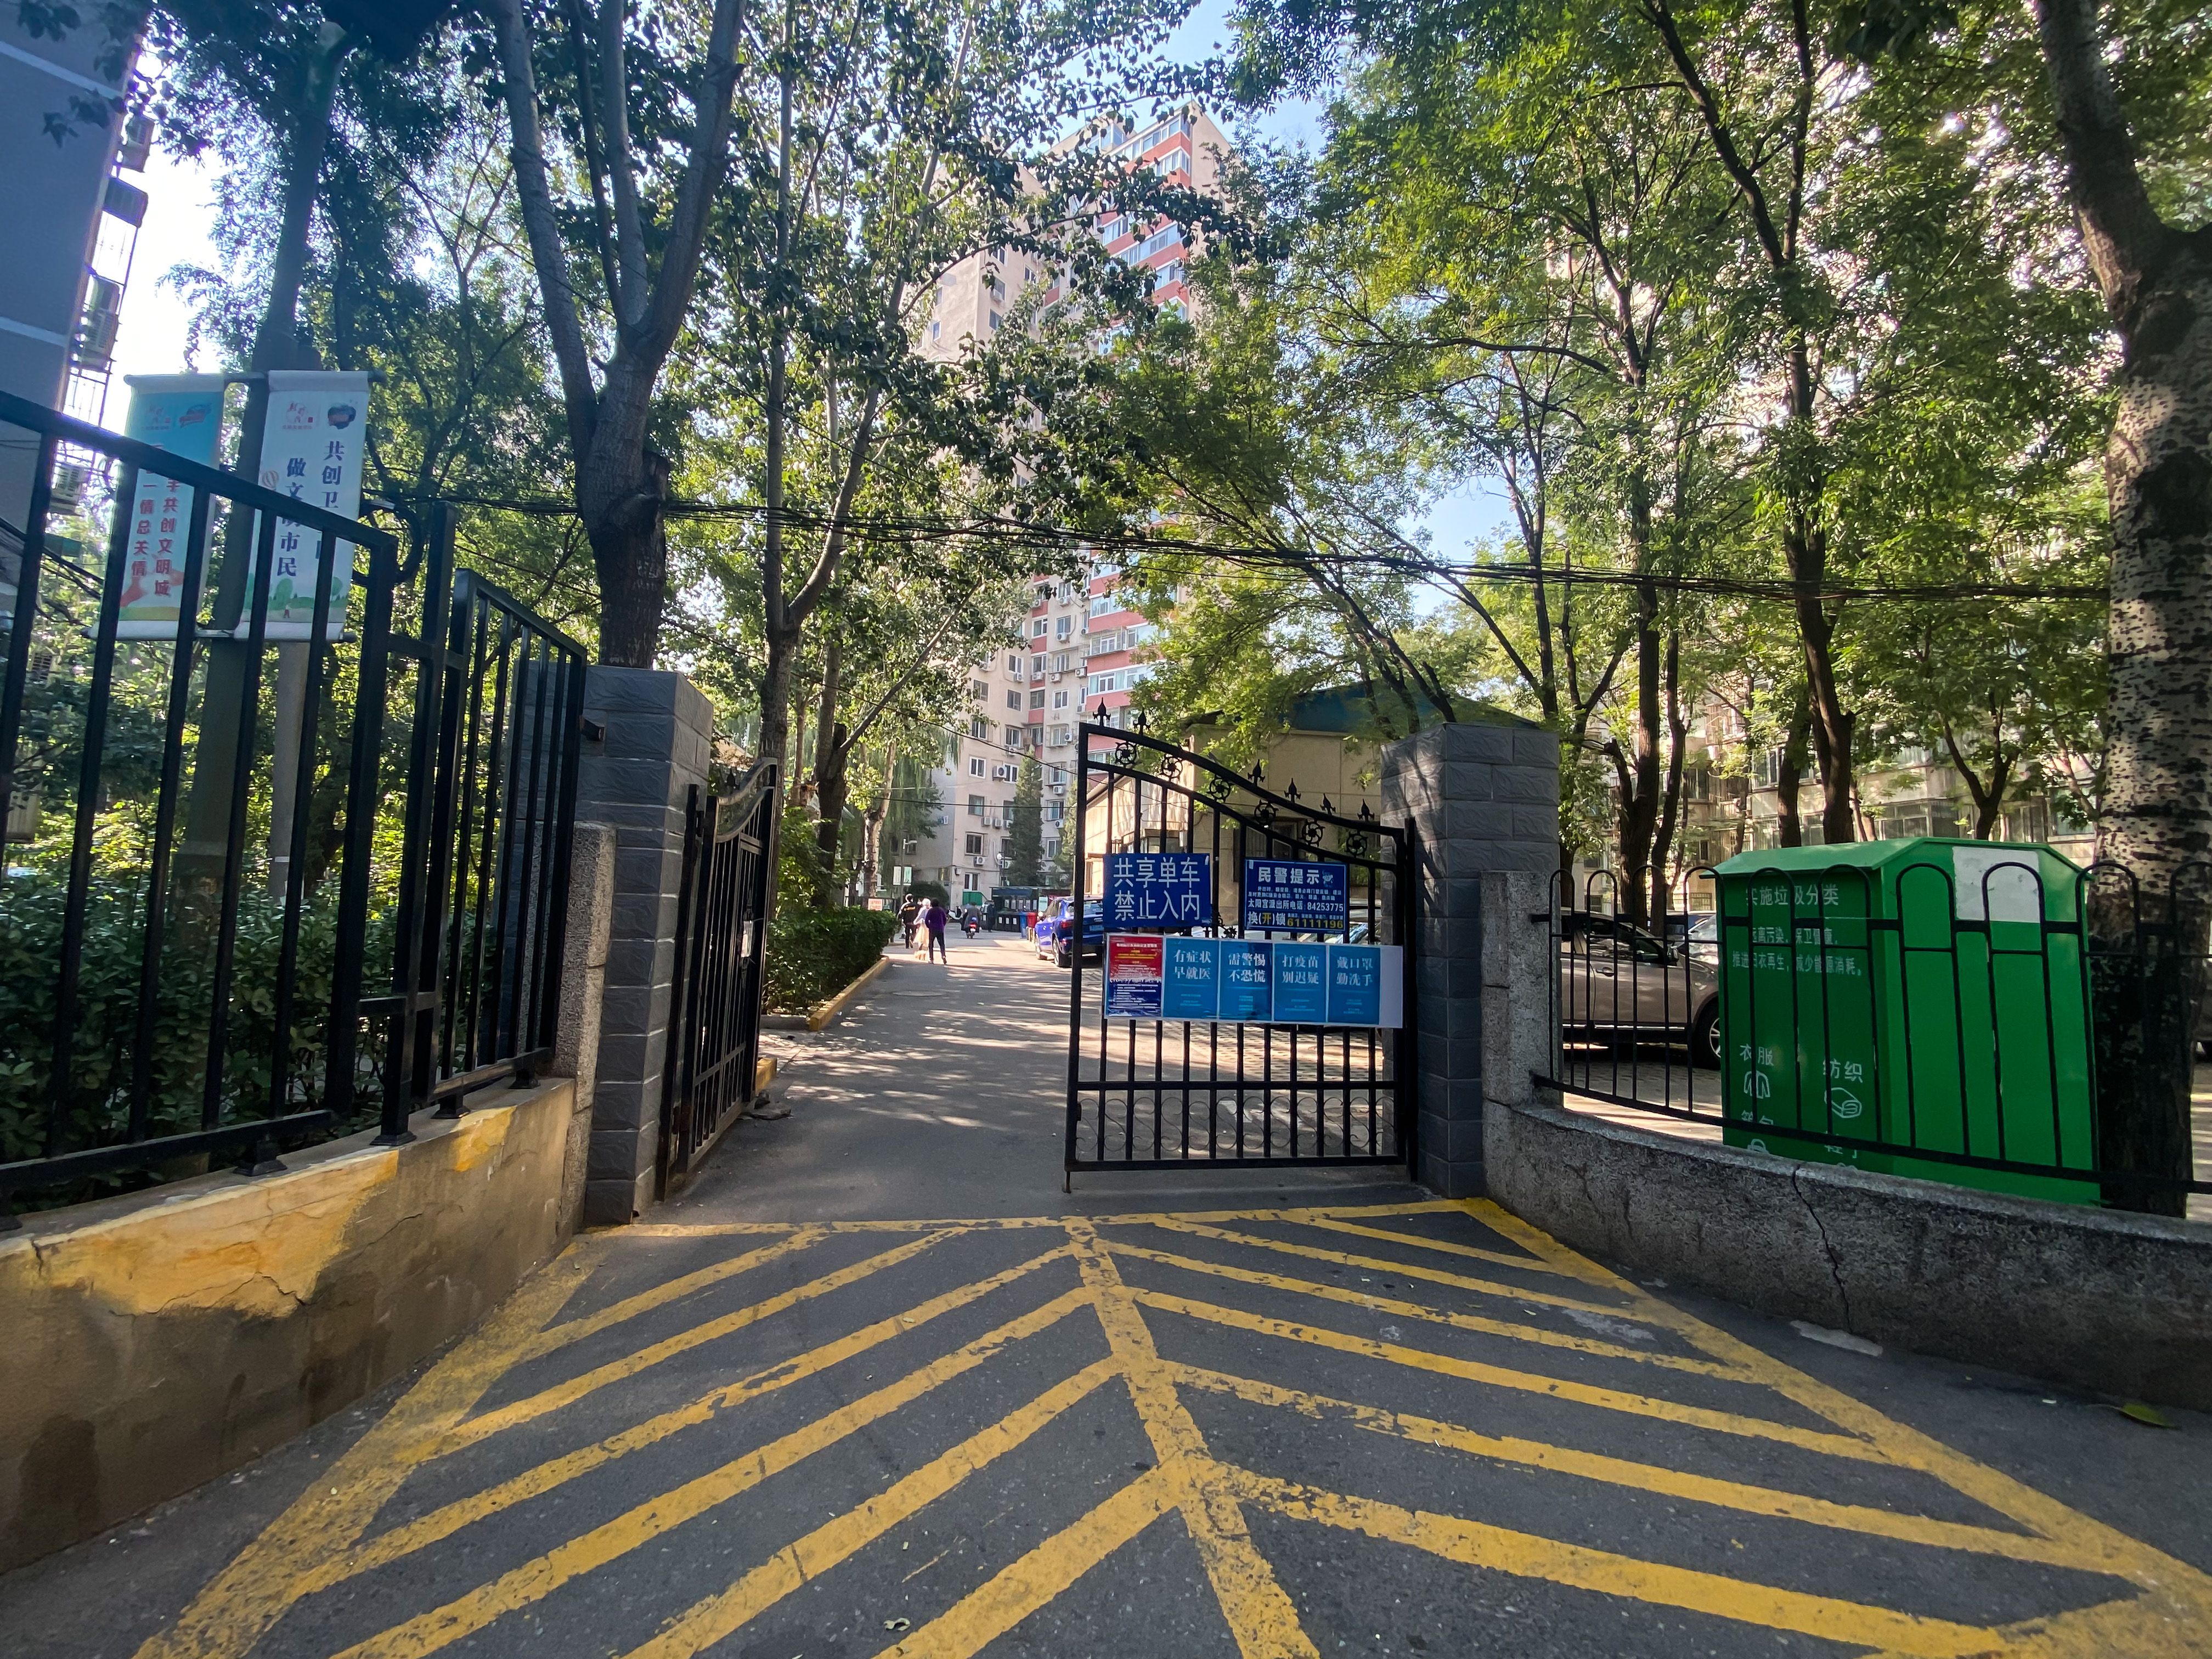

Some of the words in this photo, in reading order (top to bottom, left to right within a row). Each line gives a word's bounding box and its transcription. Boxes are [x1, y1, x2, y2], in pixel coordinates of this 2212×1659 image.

[1113, 856, 1200, 889] 共享单车
[1258, 867, 1319, 885] 民警提示
[1114, 889, 1200, 921] 禁止入内
[1287, 918, 1344, 929] 61111196
[1173, 949, 1211, 963] 有症状
[1282, 954, 1319, 968] 打疫苗
[1336, 956, 1373, 970] 戴口罩
[1173, 966, 1211, 980] 早就医
[1228, 969, 1266, 983] 不恐慌
[1282, 970, 1319, 985] 别迟疑
[1336, 972, 1373, 986] 勤洗手
[1739, 1043, 1774, 1066] 衣服
